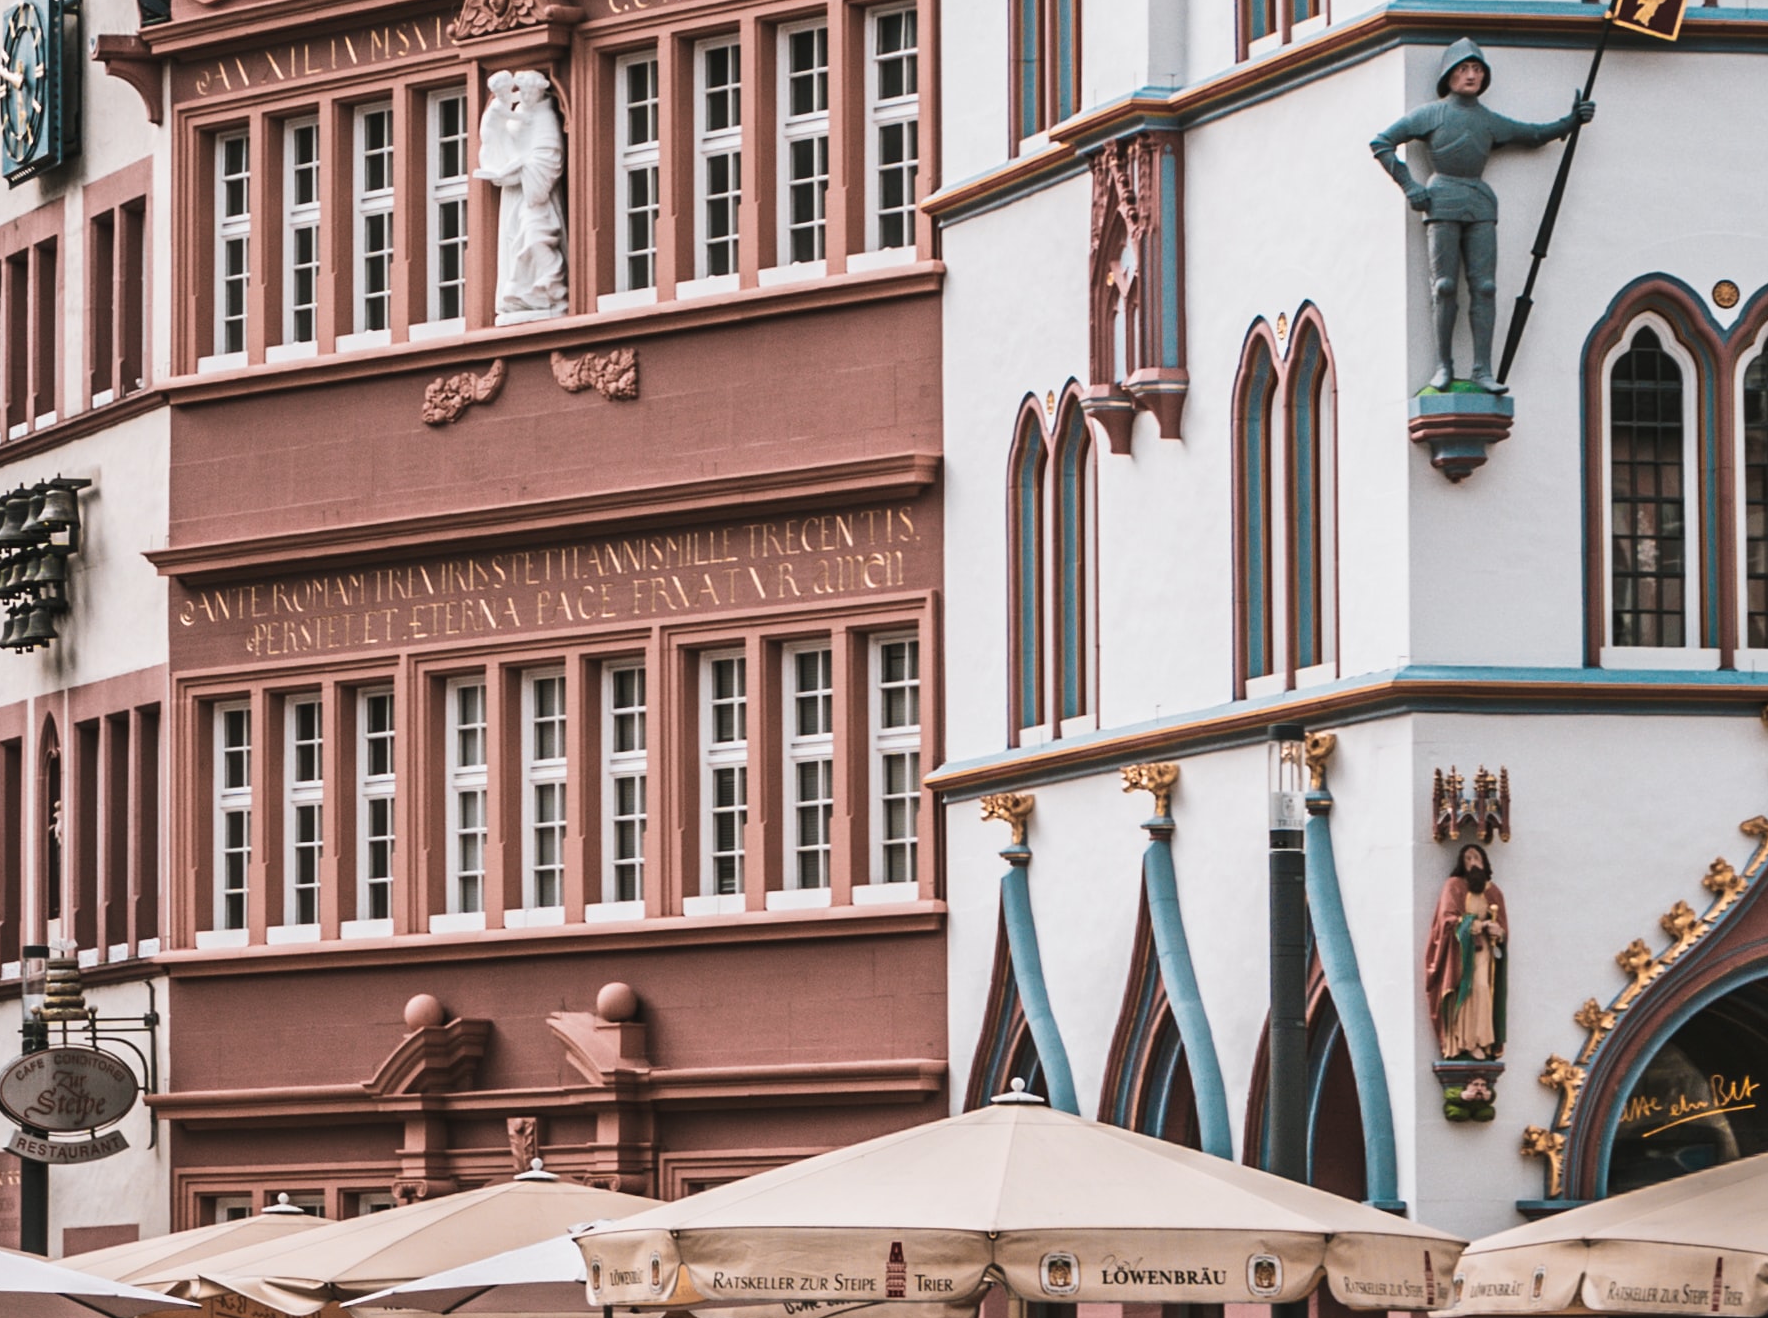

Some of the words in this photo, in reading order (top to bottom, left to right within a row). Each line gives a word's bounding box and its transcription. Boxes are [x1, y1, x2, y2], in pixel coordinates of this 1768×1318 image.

[199, 584, 267, 623] ANTE
[536, 584, 617, 625] PACE
[24, 1087, 107, 1125] Steipe
[17, 1137, 120, 1159] RESTAURANT
[1101, 1266, 1227, 1285] LÖWENBRÄU
[1469, 1280, 1524, 1299] LÖWENBRÄU
